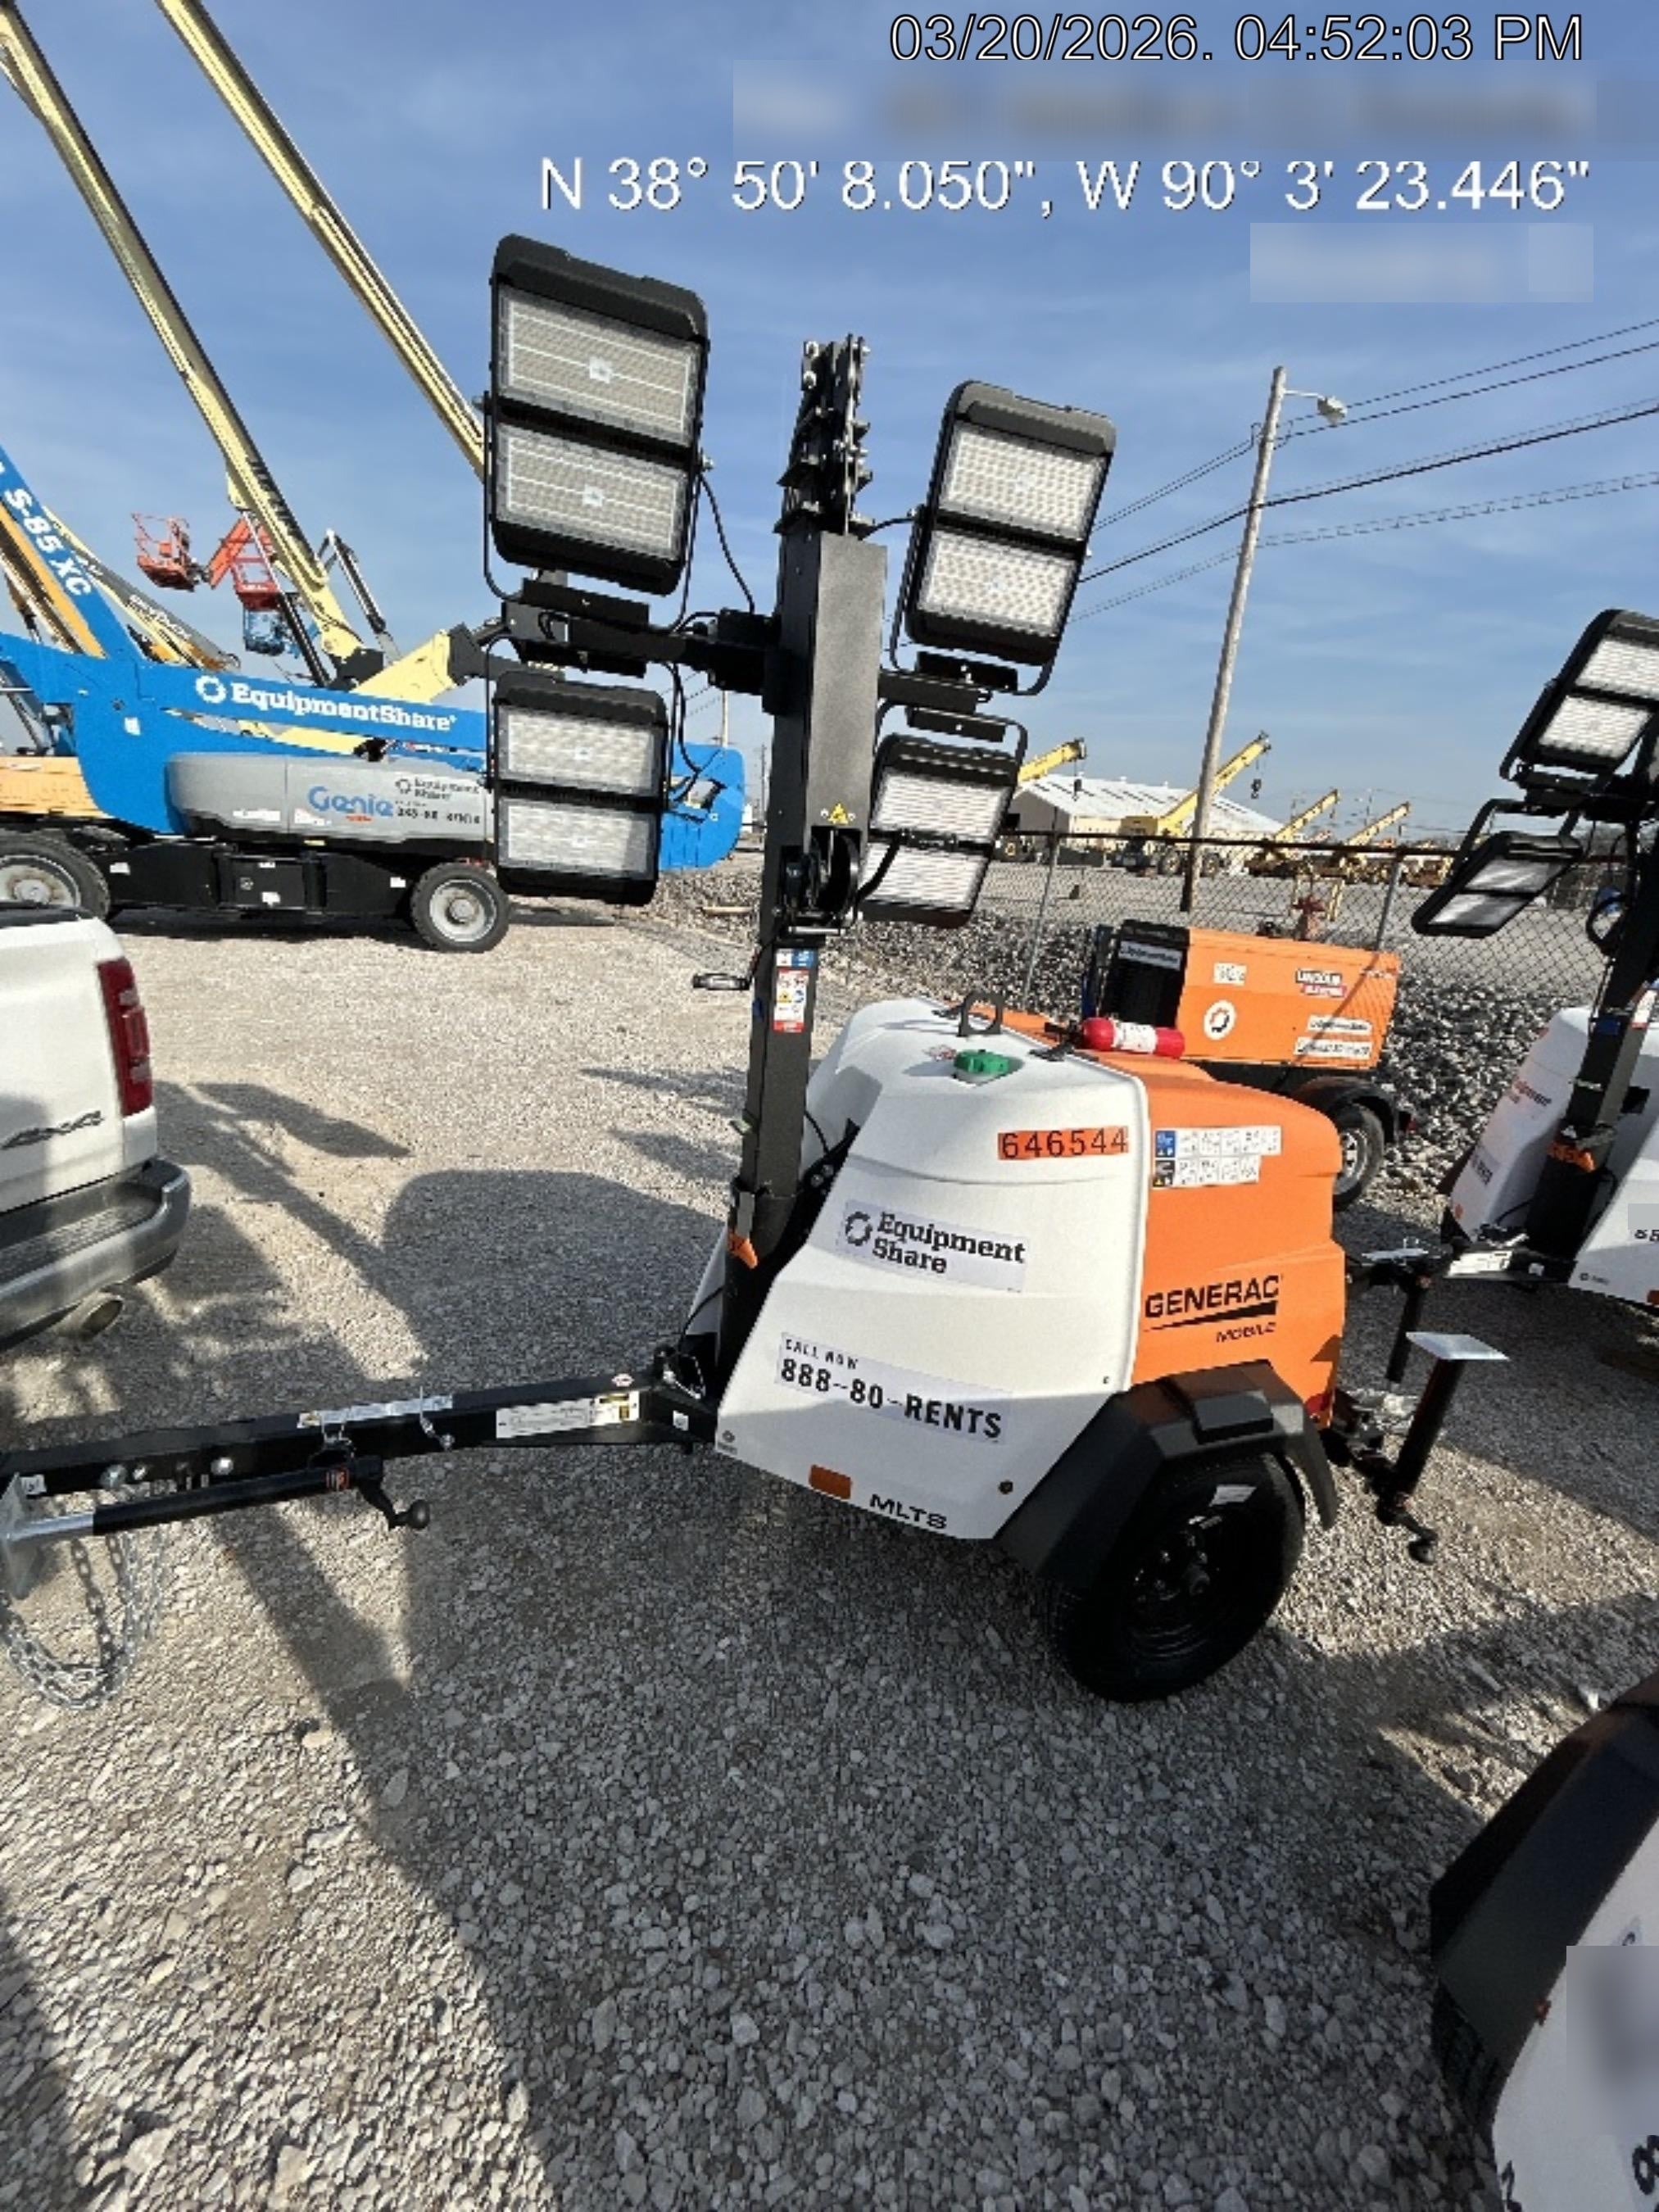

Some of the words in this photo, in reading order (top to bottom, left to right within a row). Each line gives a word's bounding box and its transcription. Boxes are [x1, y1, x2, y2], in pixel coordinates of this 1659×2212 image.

[4, 488, 66, 553] S-85
[48, 557, 93, 596] XC
[229, 682, 454, 732] EquipmentShare
[308, 786, 394, 818] Genie
[1001, 1127, 1128, 1159] 646544
[872, 1236, 948, 1275] Share
[877, 1211, 1026, 1264] Equipment
[1145, 1274, 1280, 1318] GENERAC
